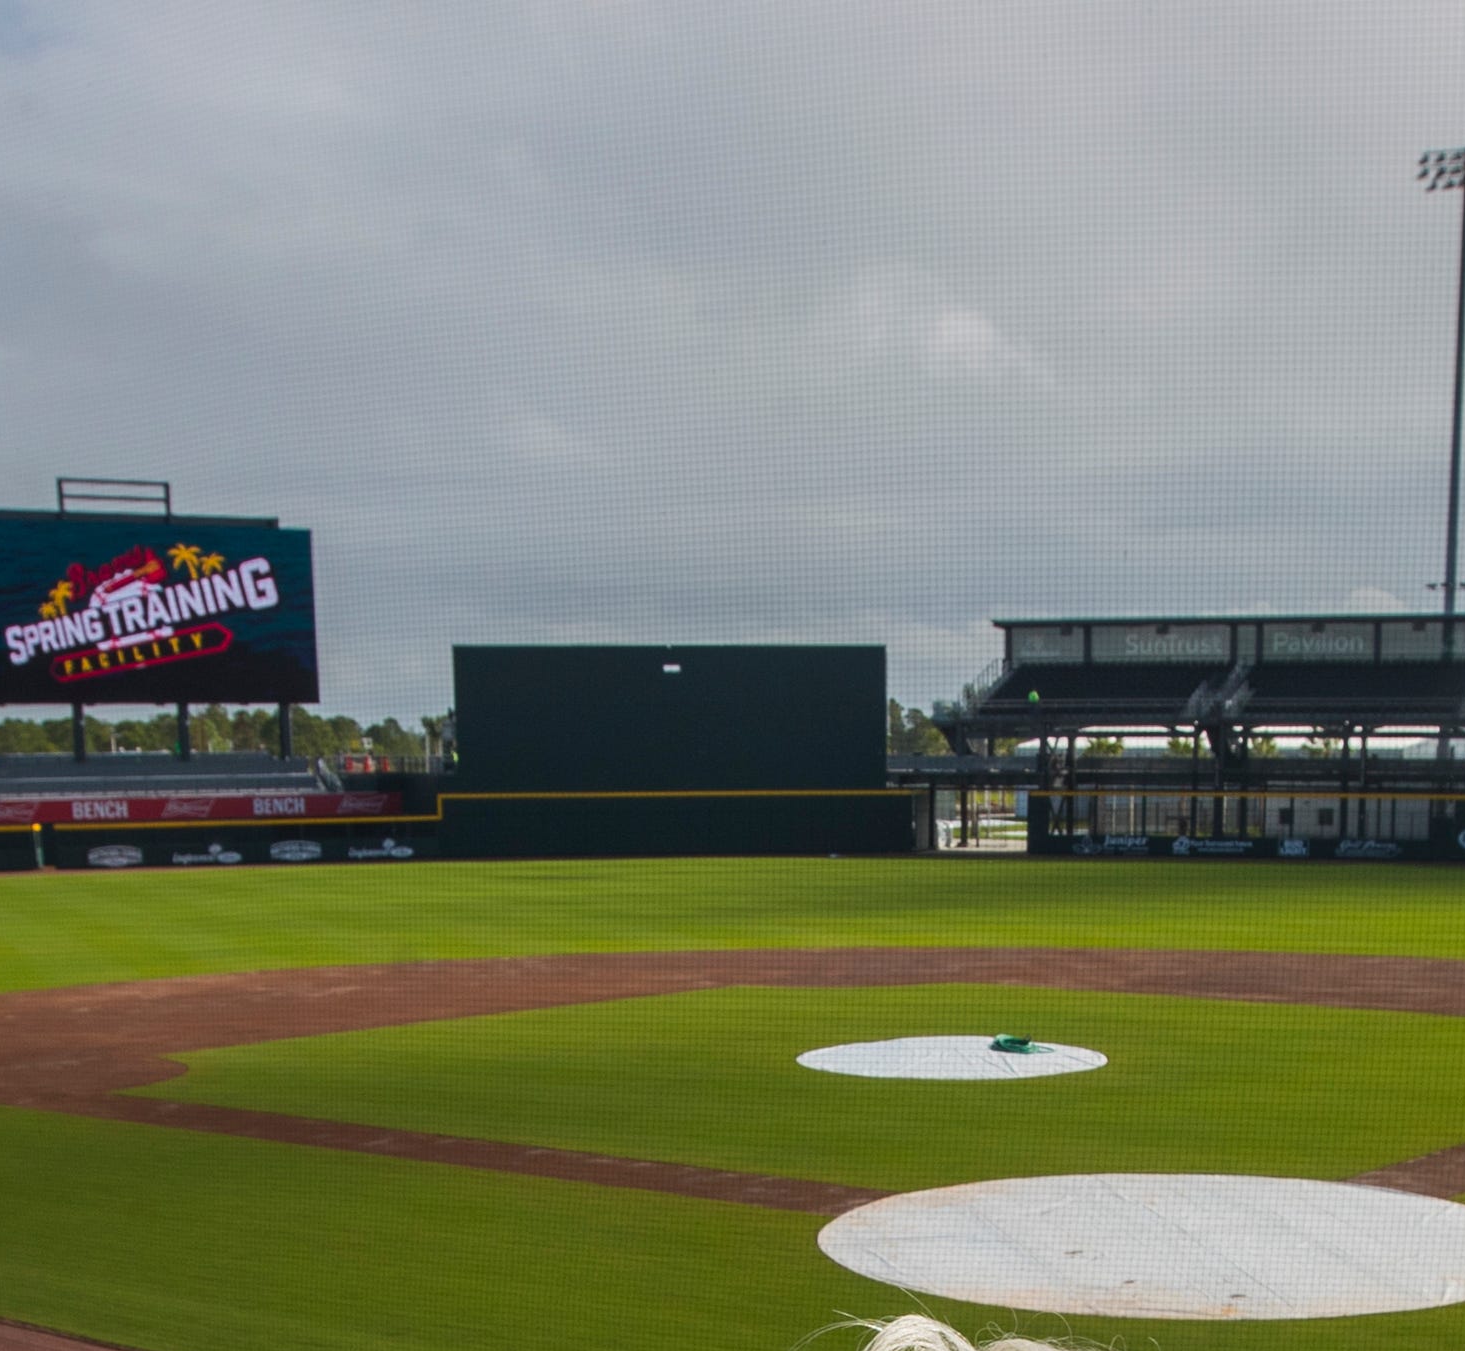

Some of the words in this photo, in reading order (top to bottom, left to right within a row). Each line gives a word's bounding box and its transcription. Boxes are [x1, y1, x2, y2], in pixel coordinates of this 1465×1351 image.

[5, 606, 101, 666] SPRING
[102, 556, 280, 637] TRAINING
[63, 632, 205, 676] FACILITY
[1124, 632, 1222, 655] SunTrust
[1272, 631, 1365, 654] Pavilion
[72, 800, 130, 820] BENCH
[252, 797, 306, 816] BENCH
